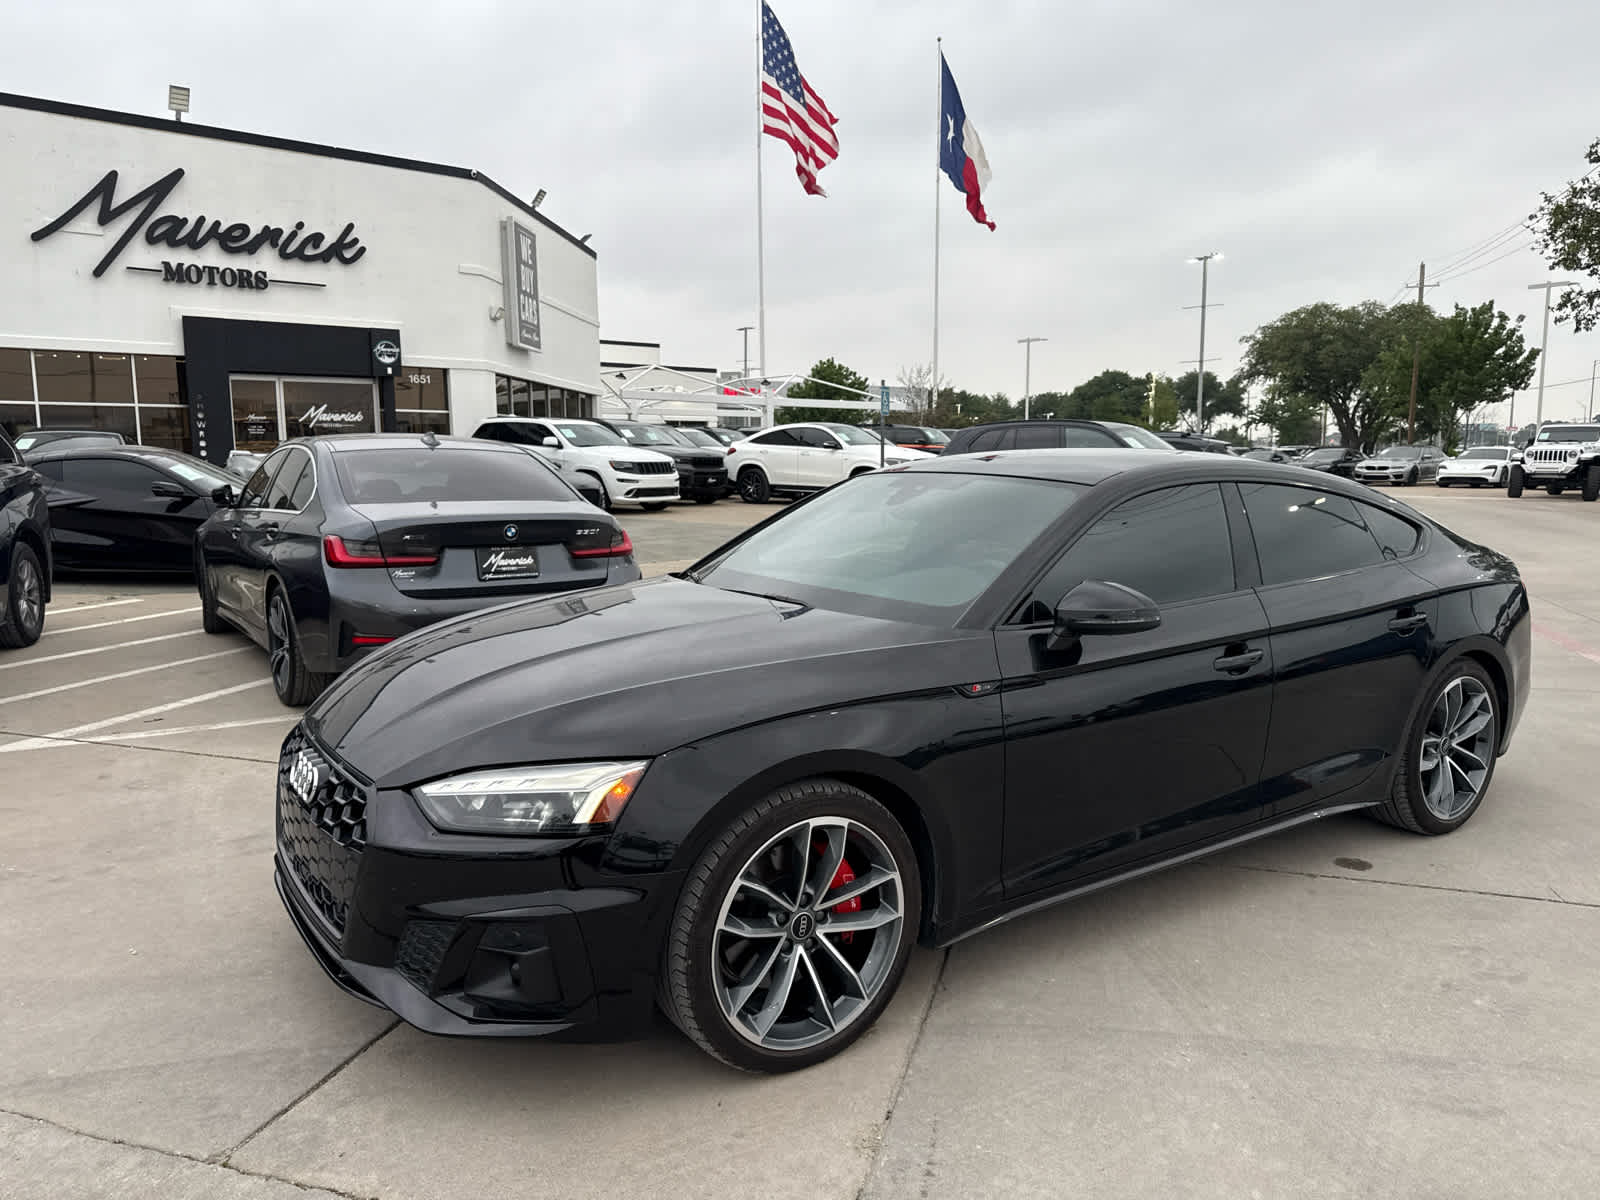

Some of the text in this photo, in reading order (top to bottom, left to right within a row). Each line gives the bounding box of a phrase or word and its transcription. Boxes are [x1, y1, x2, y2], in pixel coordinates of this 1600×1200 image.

[31, 167, 367, 277] Maverick
[162, 260, 269, 290] MOTORS
[520, 293, 538, 326] CARS
[408, 374, 431, 385] 1651
[298, 403, 364, 428] Maverick
